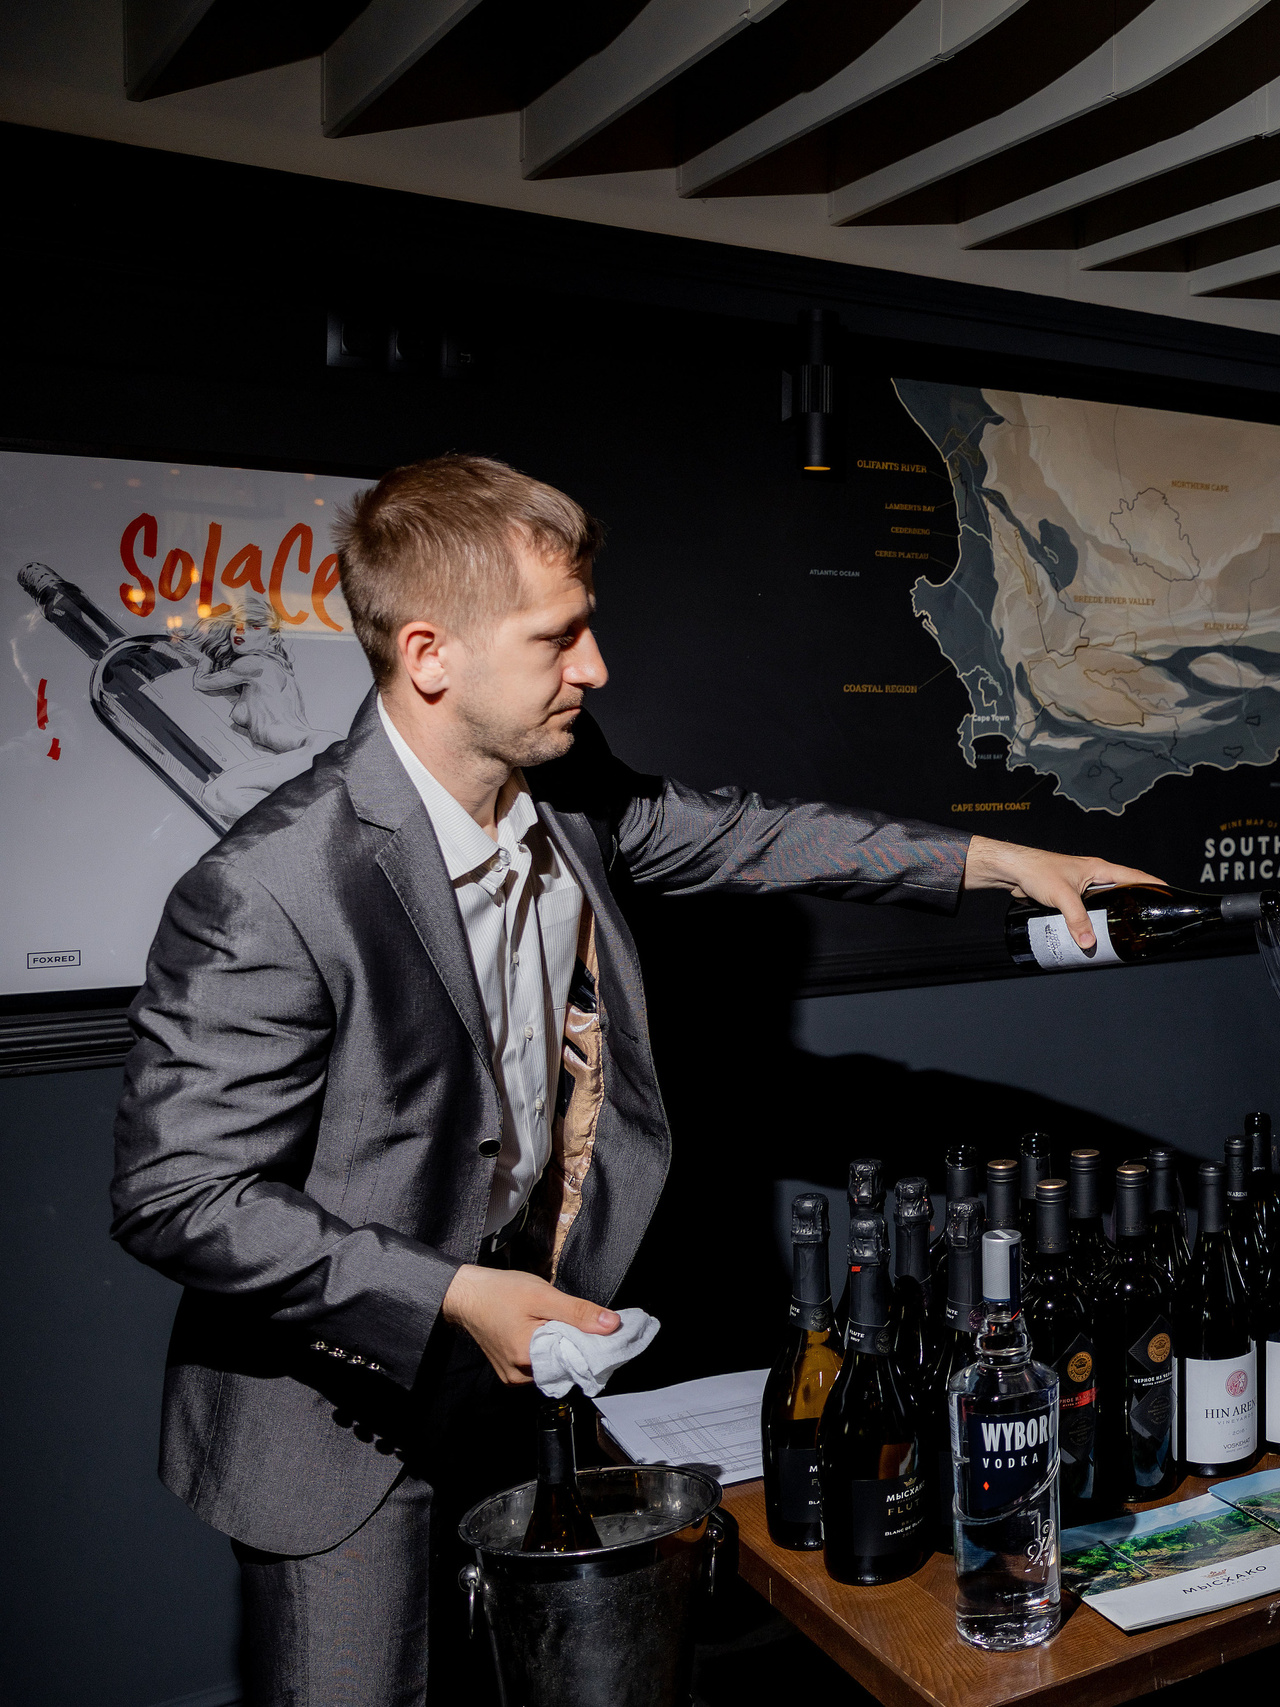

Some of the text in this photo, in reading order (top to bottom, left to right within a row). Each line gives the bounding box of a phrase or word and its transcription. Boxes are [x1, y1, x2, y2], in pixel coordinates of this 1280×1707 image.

[857, 459, 928, 474] OLIFANTS RIVER
[1171, 480, 1230, 492] NORTHERN CAPE
[884, 502, 921, 512] LAMBERTS
[890, 526, 931, 536] CEDERBERG
[874, 549, 929, 560] CERES PLATEAU
[809, 568, 838, 577] ATLANTIC
[1074, 595, 1156, 606] BREEDE RIVER VALLEY
[843, 683, 918, 694] COASTAL REGION
[972, 713, 1010, 723] Cape Town
[951, 801, 1032, 812] CAPE SOUTH COAST
[1219, 818, 1278, 832] WINE MAP OF
[32, 955, 76, 964] FOXRED
[1205, 1407, 1230, 1419] HIN
[982, 1453, 1039, 1469] VODKA
[884, 1528, 904, 1537] BLANC
[1182, 1565, 1267, 1594] МЫСХАКО
